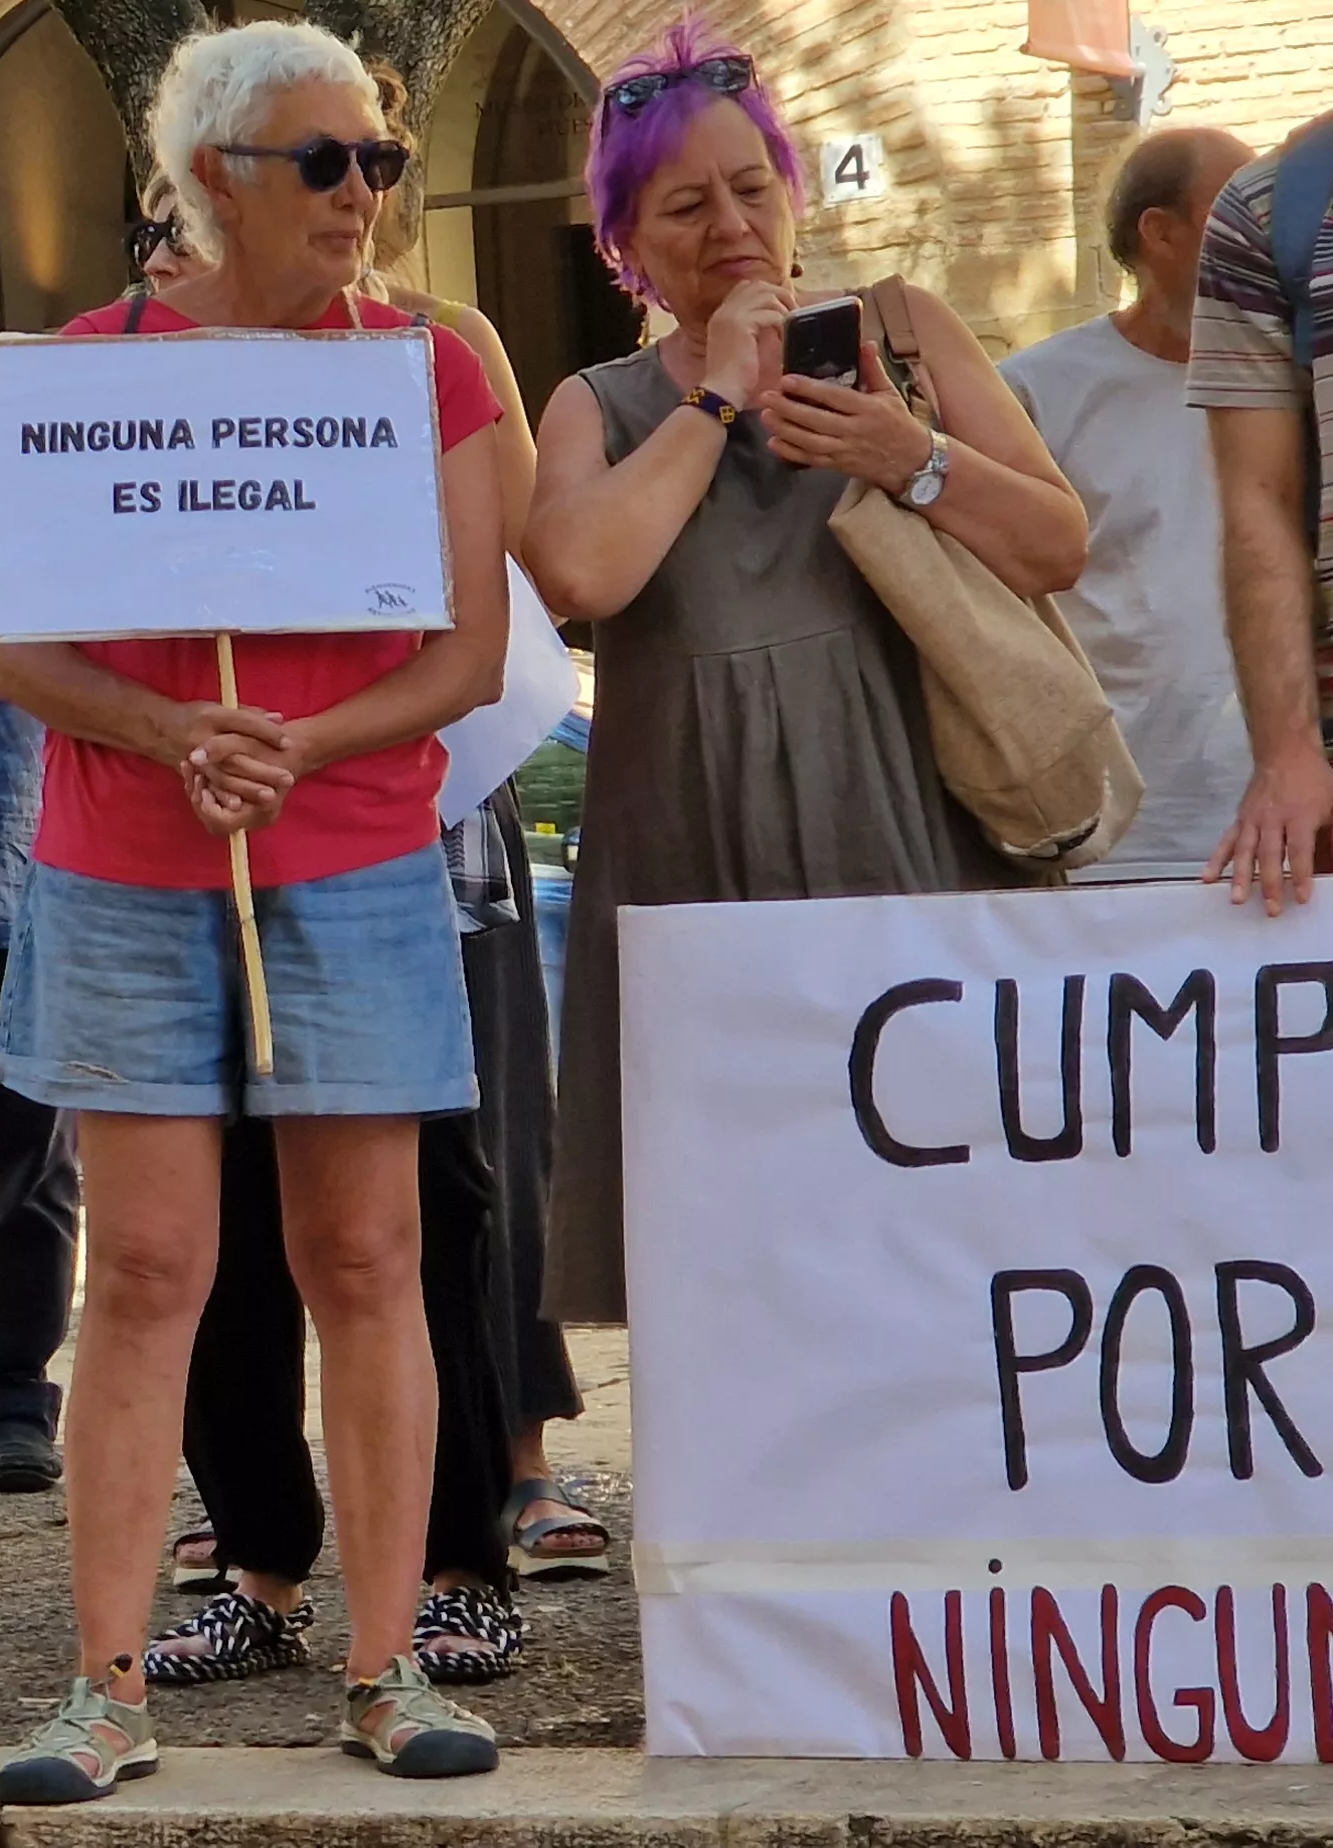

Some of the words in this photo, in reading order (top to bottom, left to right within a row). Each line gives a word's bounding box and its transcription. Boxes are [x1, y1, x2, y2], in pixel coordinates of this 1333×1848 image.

[834, 143, 870, 190] 4
[20, 419, 196, 455] NINGUNA
[211, 416, 399, 450] PERSONA
[112, 481, 162, 514] ES
[178, 479, 317, 513] ILEGAL
[847, 961, 1333, 1168] CUMP
[990, 1259, 1323, 1492] POR
